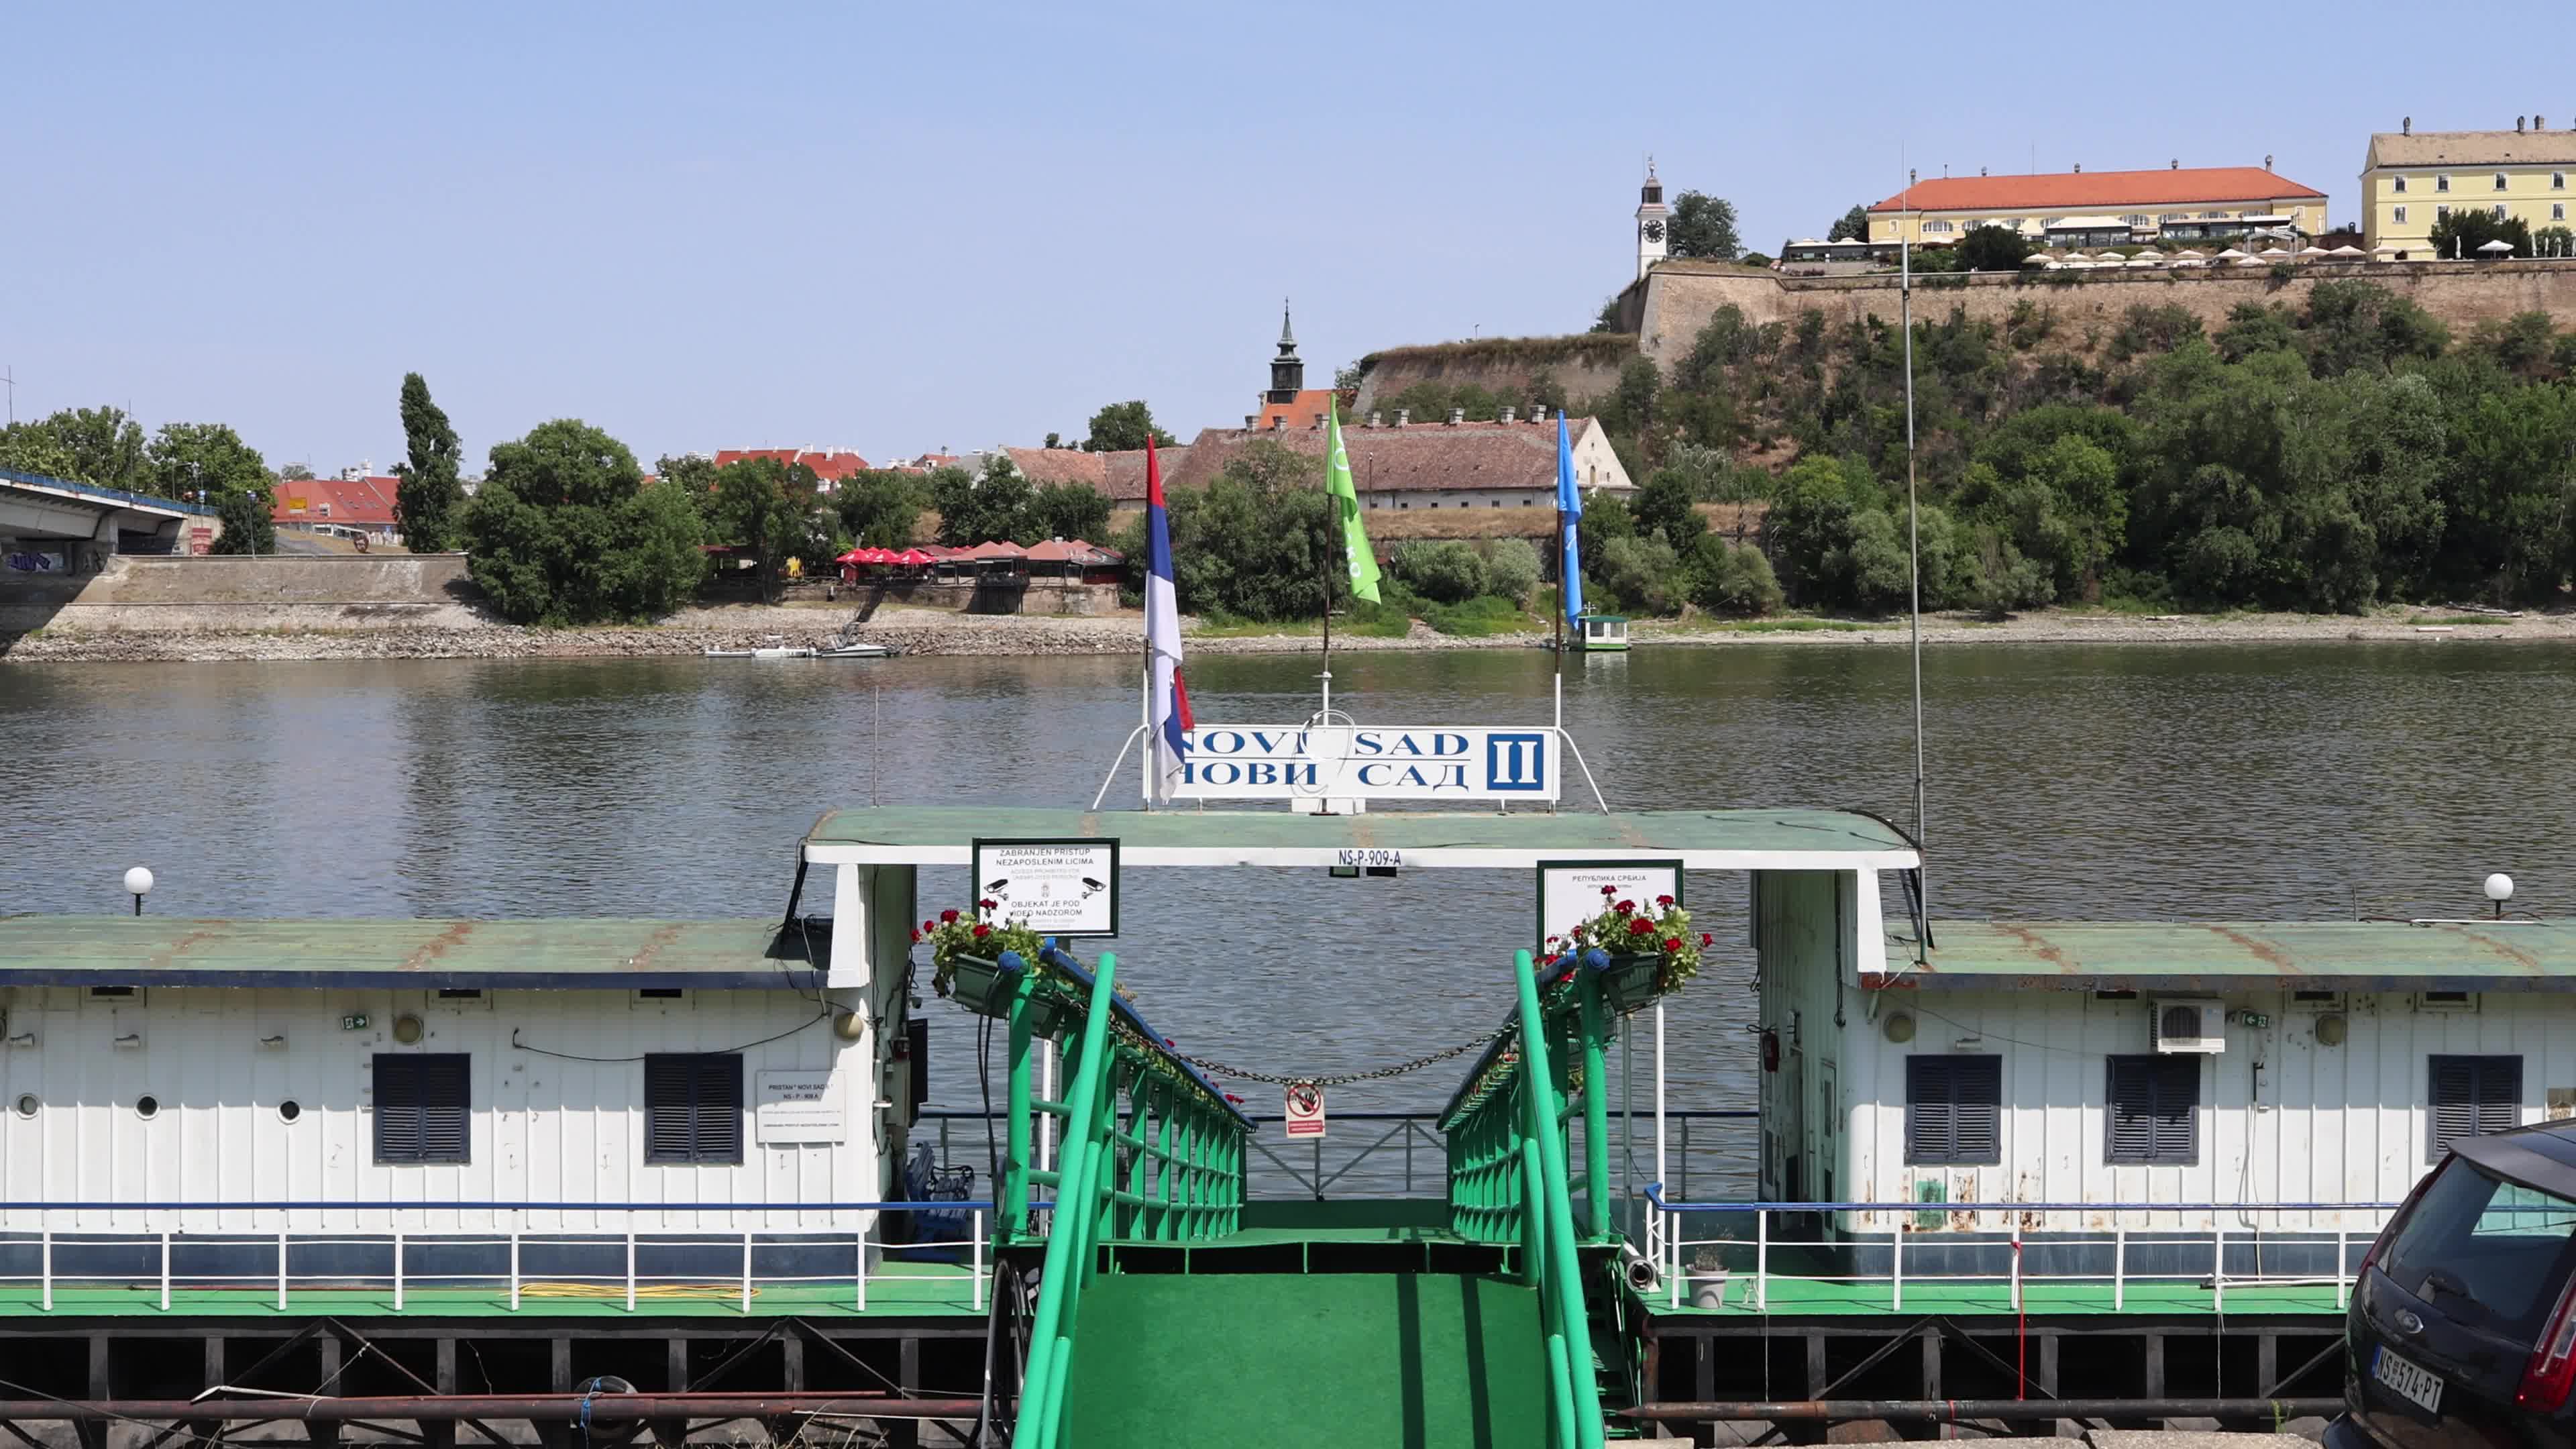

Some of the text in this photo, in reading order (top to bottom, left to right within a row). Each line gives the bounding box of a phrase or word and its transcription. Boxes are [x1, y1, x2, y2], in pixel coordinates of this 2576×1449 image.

[1354, 732, 1469, 755] SAD
[1357, 764, 1469, 792] САД
[1000, 848, 1091, 857] ZABRANJEN PRISTUP
[1339, 849, 1401, 865] NS-P-909-A
[996, 857, 1094, 866] NEZAPOSLENIM LICIMA
[1011, 900, 1049, 908] OBJEKAT
[1036, 909, 1083, 917] NADZOROM
[2377, 1351, 2392, 1381] NS
